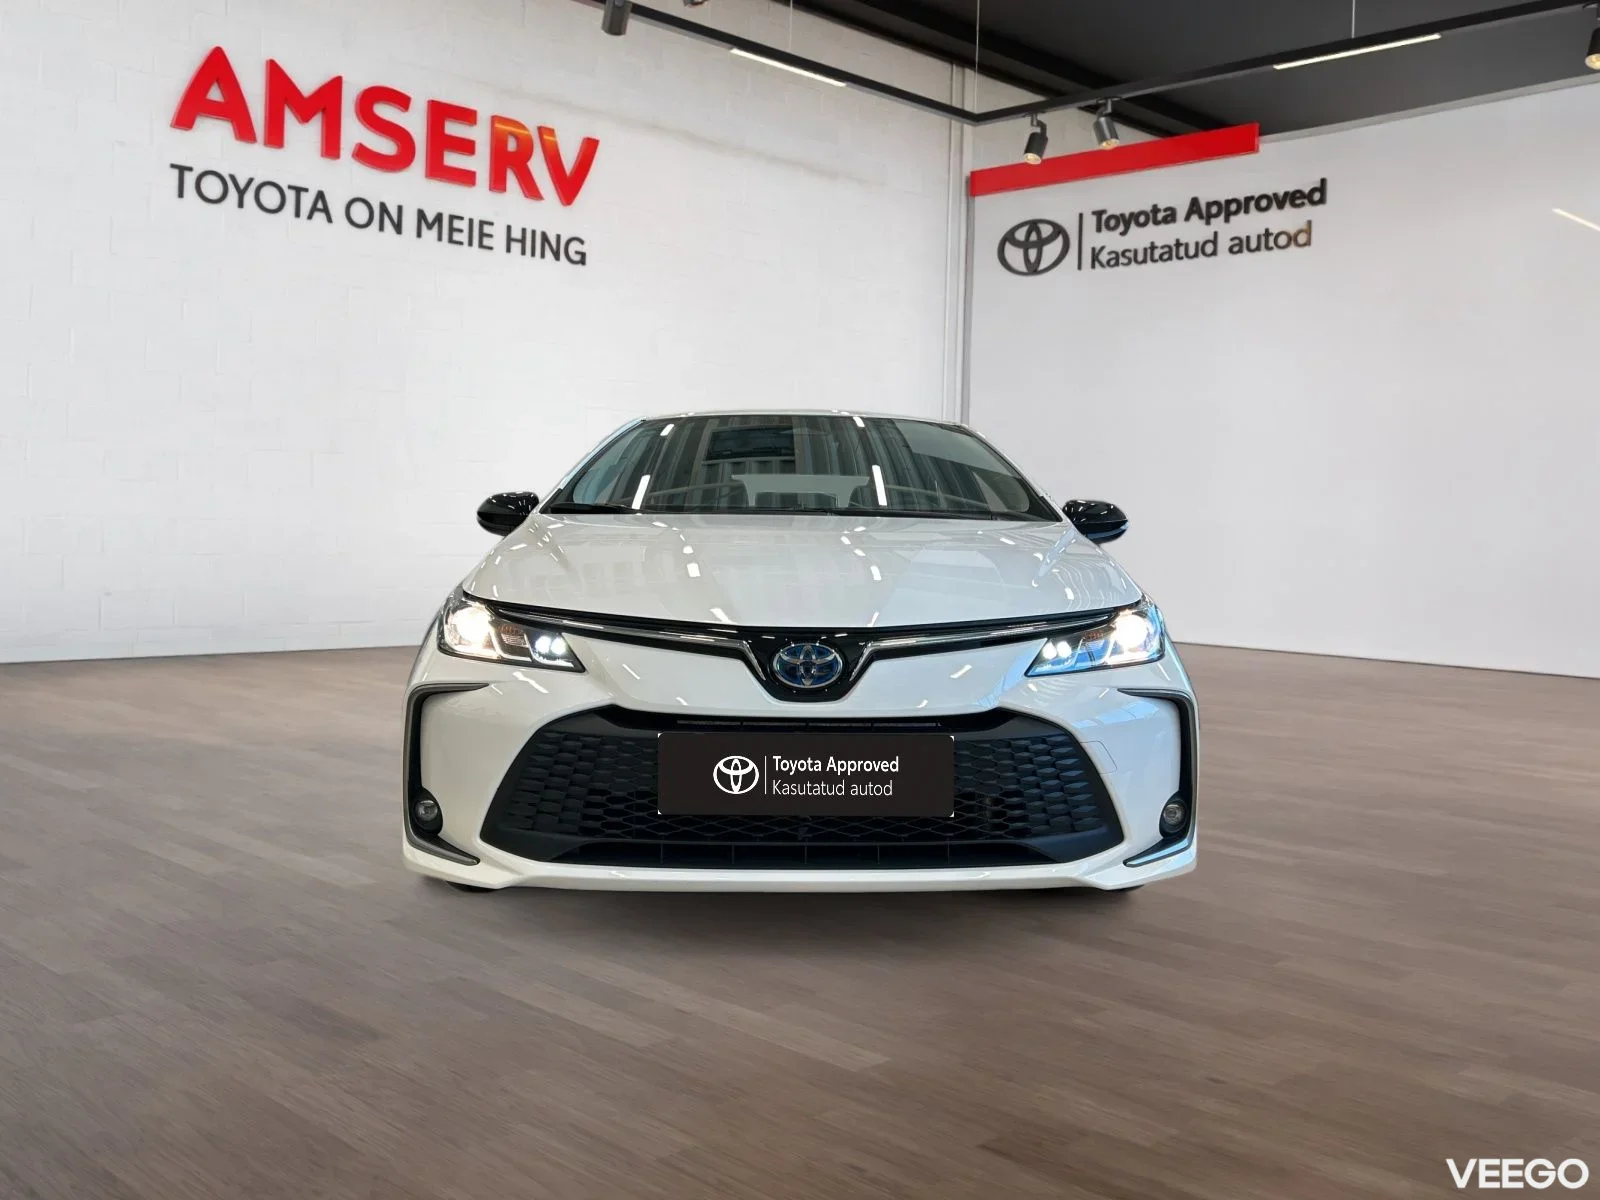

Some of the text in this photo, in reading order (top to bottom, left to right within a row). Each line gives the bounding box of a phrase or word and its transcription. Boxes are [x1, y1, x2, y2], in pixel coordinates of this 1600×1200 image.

[170, 46, 600, 206] AMSERV
[169, 163, 587, 266] TOYOTA ON MEIE HING
[1092, 178, 1327, 236] Toyota Approved
[1090, 220, 1312, 269] Kasutatud autod
[772, 755, 899, 775] Toyota Approved
[772, 779, 893, 796] Kasutatud autod
